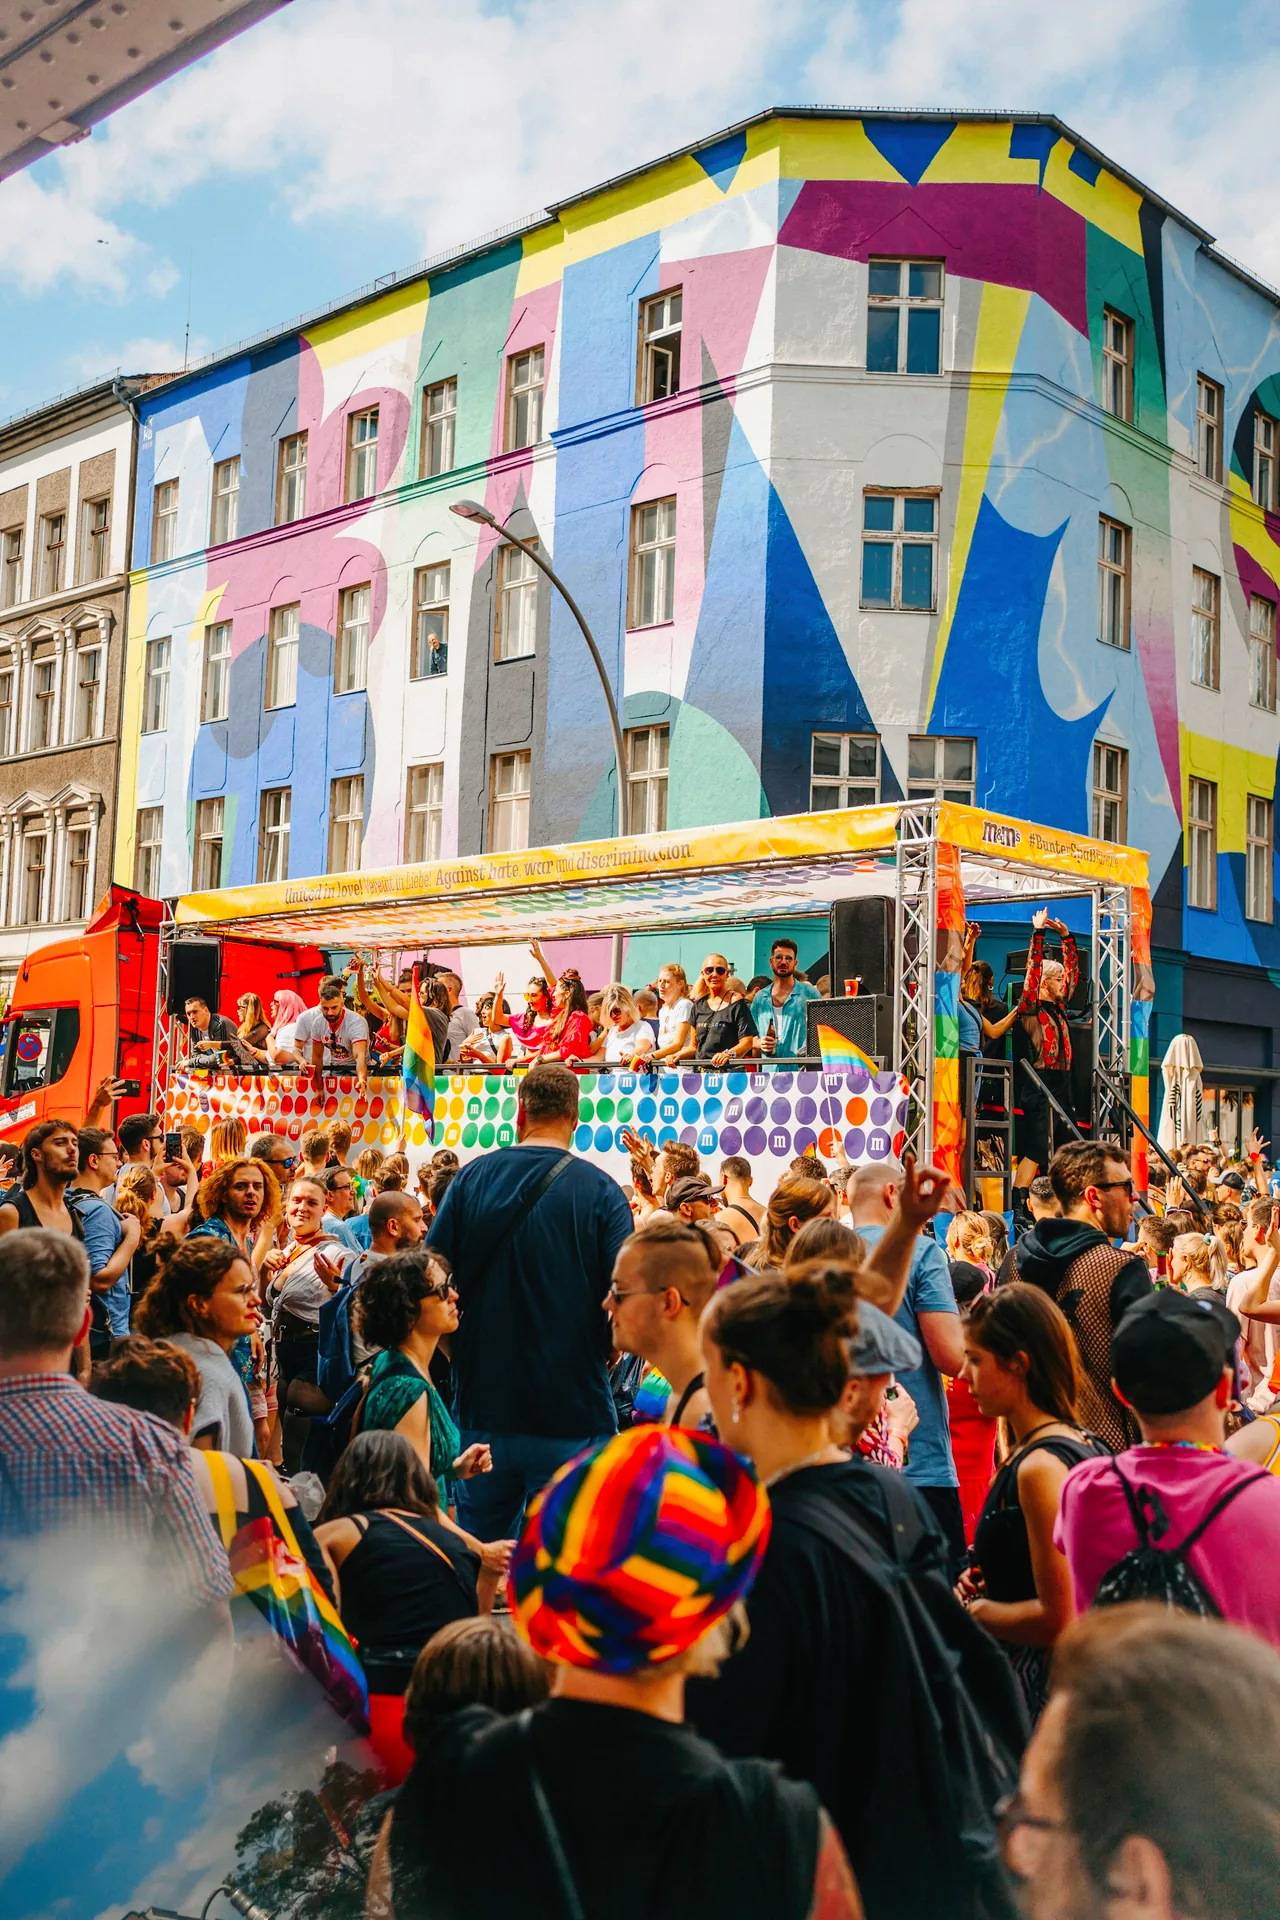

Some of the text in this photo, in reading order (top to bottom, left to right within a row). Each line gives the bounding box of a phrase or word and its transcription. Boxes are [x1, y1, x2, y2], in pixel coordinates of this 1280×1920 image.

[285, 884, 322, 905] United
[336, 879, 364, 898] love!
[405, 868, 432, 890] Liebe!
[436, 864, 486, 890] Against
[523, 859, 554, 877] war
[555, 852, 575, 874] and
[576, 844, 695, 870] discrimination.
[622, 1076, 632, 1088] m
[708, 1076, 719, 1088] m
[754, 1074, 766, 1086] m
[470, 1104, 478, 1114] m
[664, 1104, 674, 1116] m
[728, 1104, 739, 1116] m
[501, 1130, 510, 1142] m
[702, 1134, 713, 1146] m
[774, 1134, 786, 1148] m
[870, 1136, 884, 1152] m
